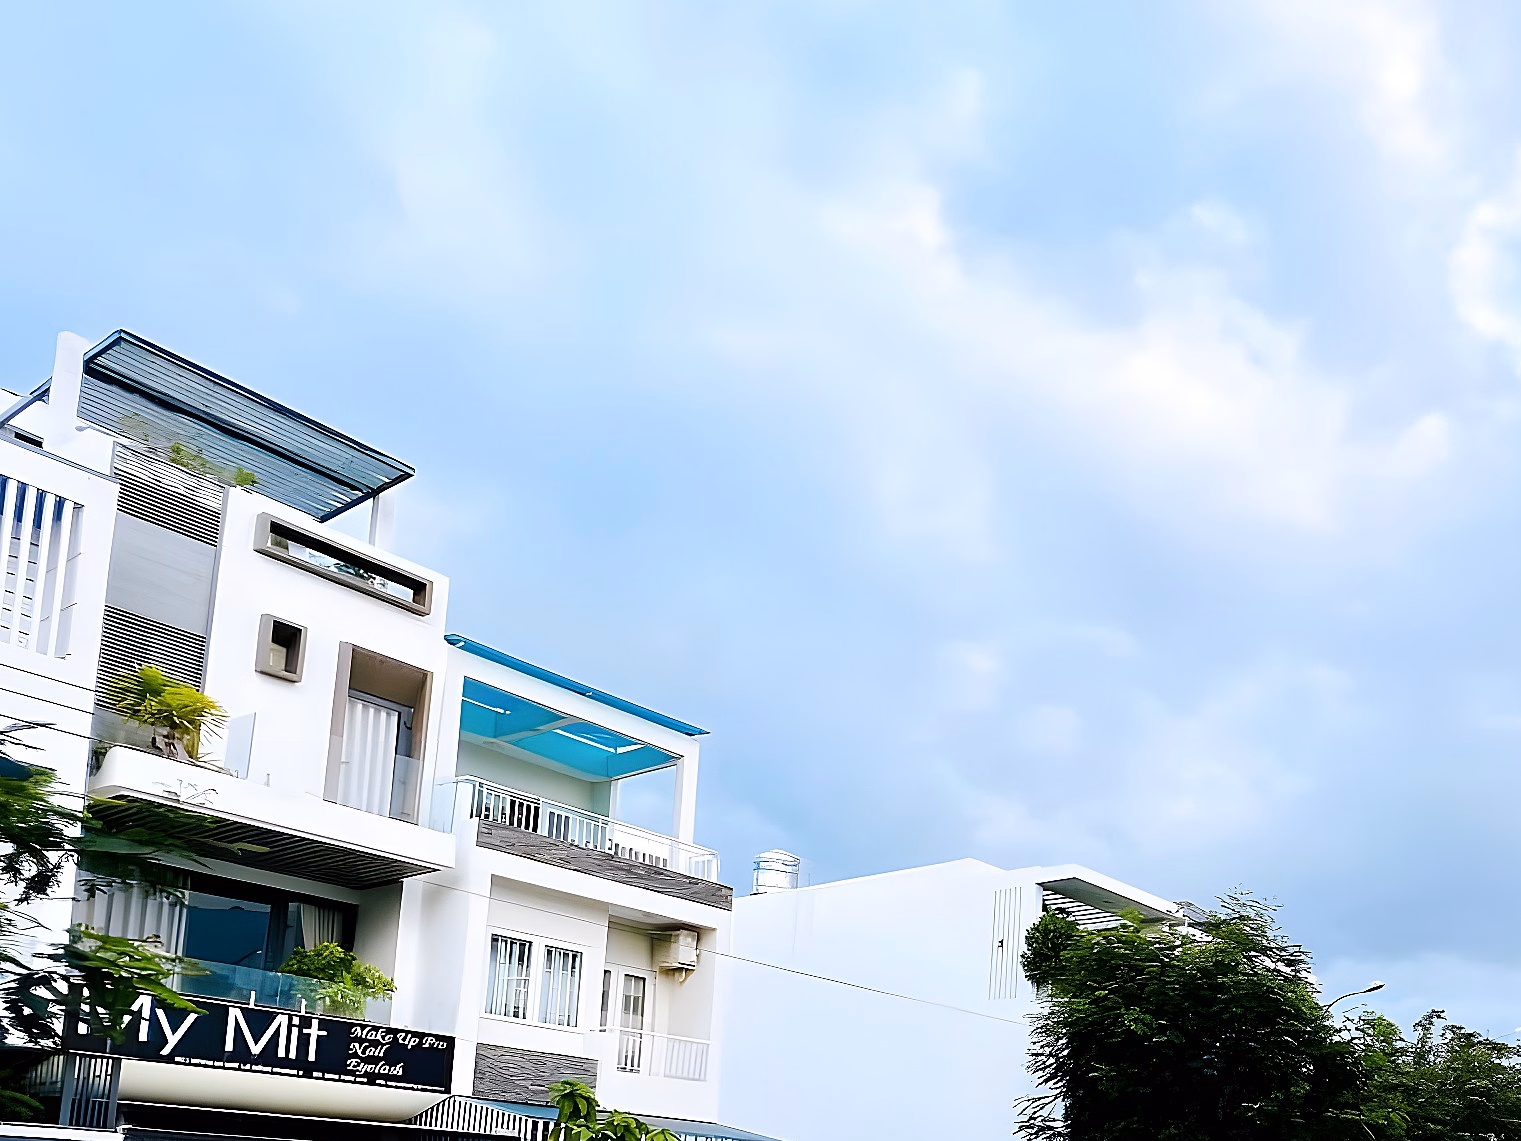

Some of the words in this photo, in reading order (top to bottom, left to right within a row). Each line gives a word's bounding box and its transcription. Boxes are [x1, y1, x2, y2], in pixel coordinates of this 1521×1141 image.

[224, 1006, 328, 1062] Mit
[349, 1026, 394, 1044] Make
[396, 1032, 420, 1050] Up
[348, 1042, 391, 1057] Nail
